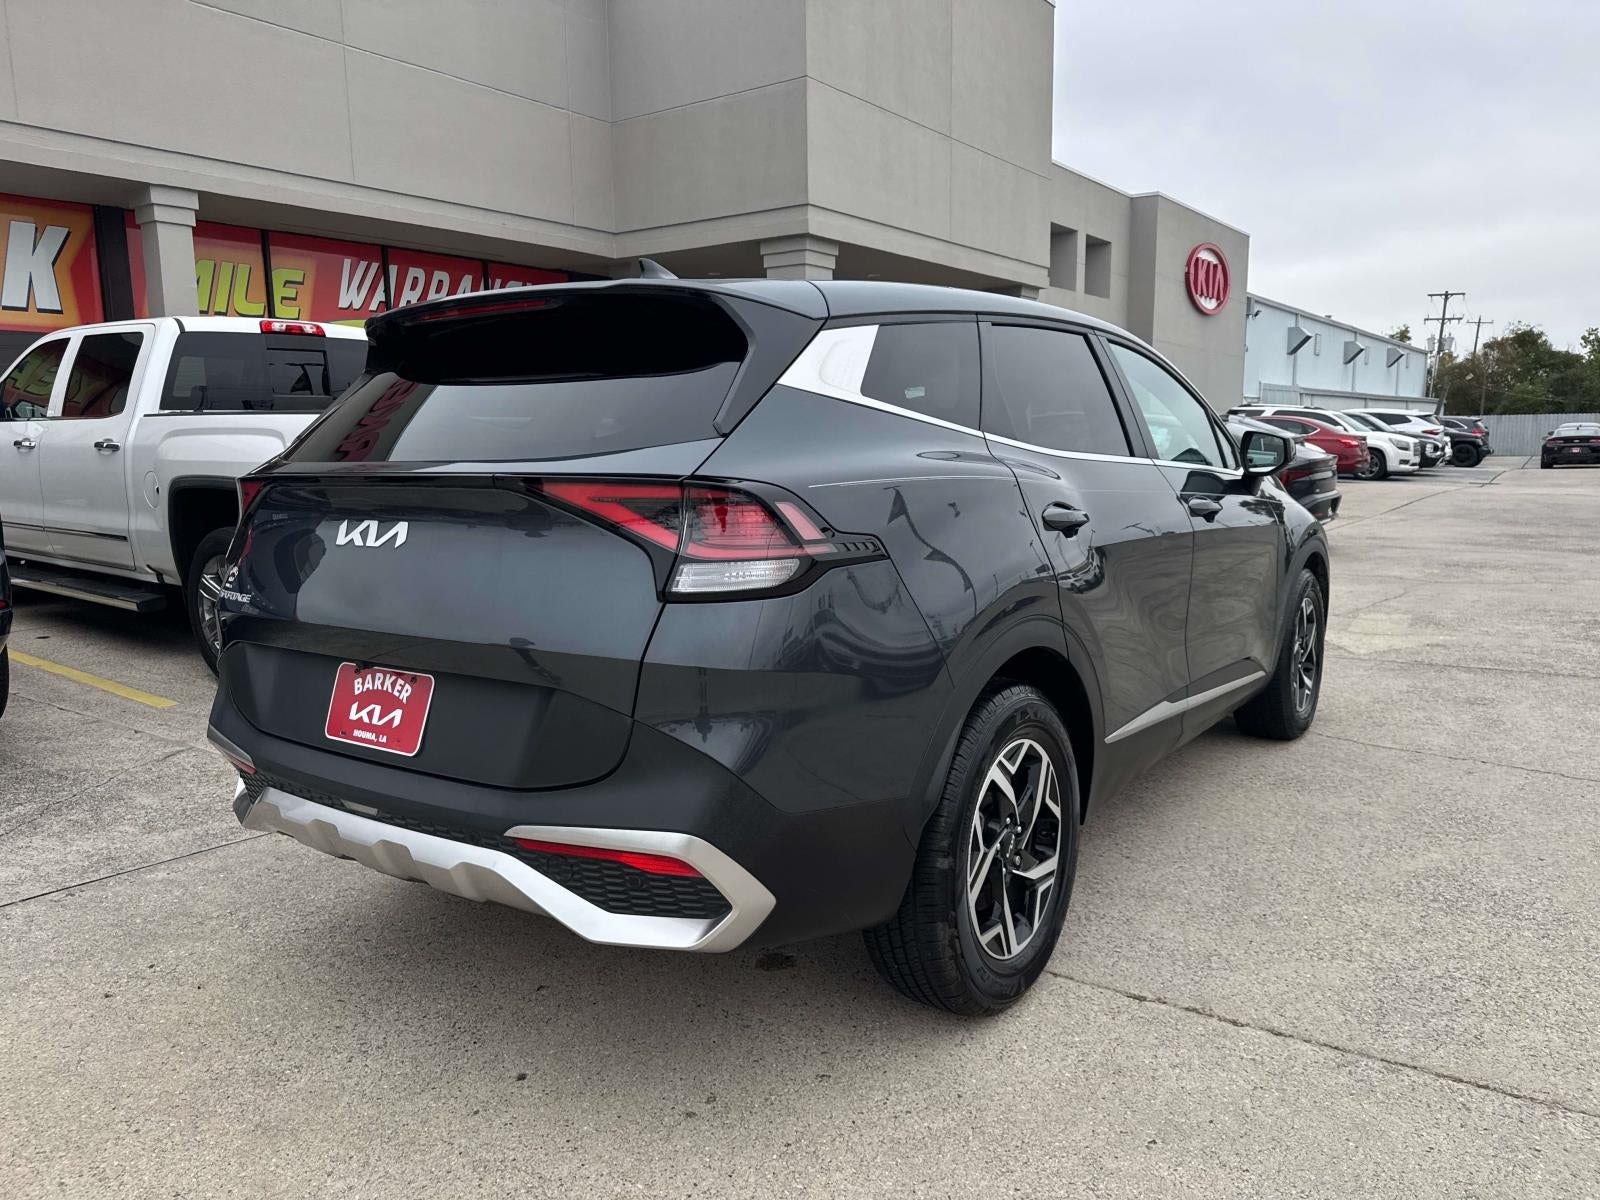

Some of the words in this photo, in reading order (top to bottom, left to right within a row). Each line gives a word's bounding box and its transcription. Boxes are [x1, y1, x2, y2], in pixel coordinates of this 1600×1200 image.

[1, 221, 70, 313] K
[338, 258, 532, 312] WARRA
[335, 519, 408, 548] KIA
[354, 672, 412, 704] BARKER
[349, 701, 403, 728] KIA
[353, 729, 377, 742] HOUMA,
[379, 734, 387, 743] LA
